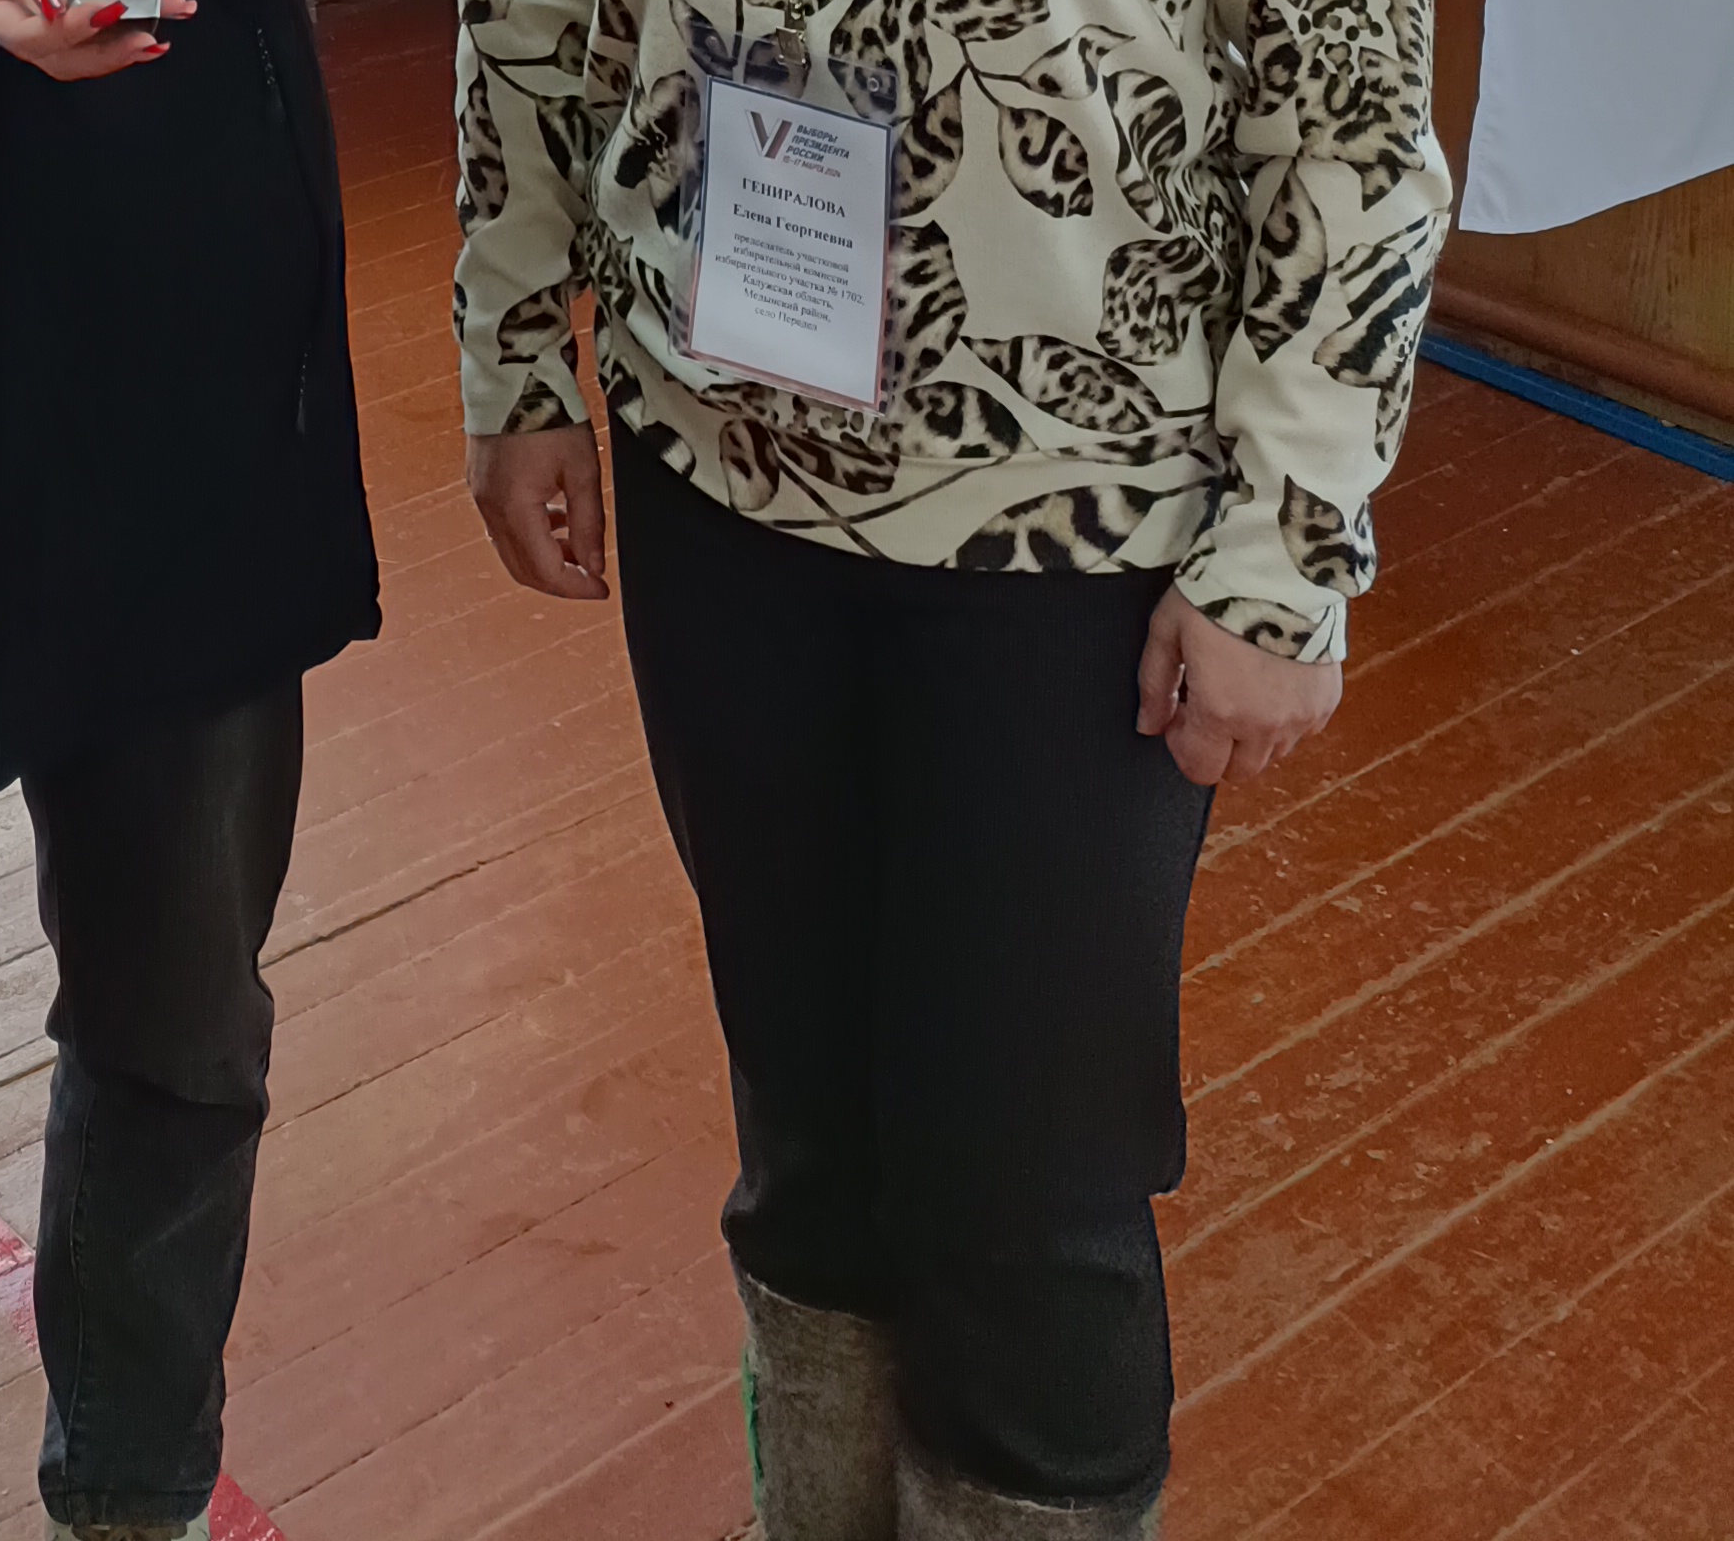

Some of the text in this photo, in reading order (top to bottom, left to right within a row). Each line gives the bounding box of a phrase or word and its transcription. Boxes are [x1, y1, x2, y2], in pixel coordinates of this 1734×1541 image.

[786, 145, 825, 163] РОССИИ
[742, 177, 846, 218] ГЕНИРАЛОВА
[733, 203, 854, 249] Елена Георгиевна
